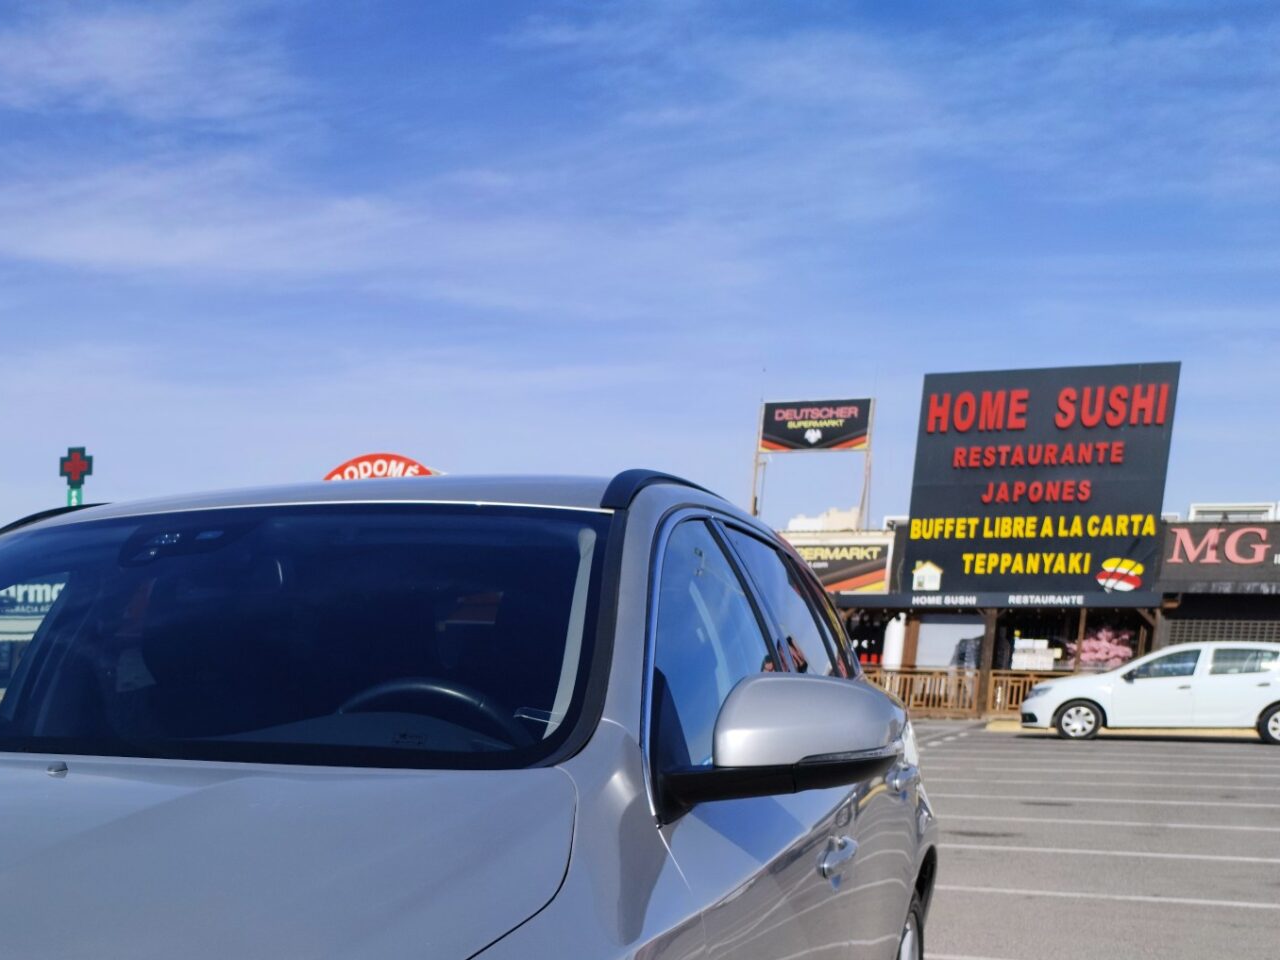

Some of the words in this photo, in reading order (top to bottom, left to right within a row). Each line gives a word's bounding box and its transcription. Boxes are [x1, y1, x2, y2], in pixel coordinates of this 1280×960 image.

[774, 405, 859, 422] DEUTSCHER
[926, 388, 1030, 434] HOME
[1054, 383, 1170, 429] SUSHI
[787, 418, 845, 430] SUPERMARKT
[952, 441, 1125, 469] RESTAURANTE
[981, 479, 1092, 504] JAPONES
[910, 517, 980, 540] BUFFET
[982, 516, 1038, 539] LIBRE
[1040, 515, 1054, 538] A
[1057, 515, 1084, 538] LA
[1086, 514, 1157, 537] CARTA
[1166, 527, 1272, 564] MG
[962, 553, 1092, 575] TEPPANYAKI
[911, 595, 942, 606] HOME
[943, 595, 977, 606] SUSHI
[1007, 594, 1084, 606] RESTAURANTE
